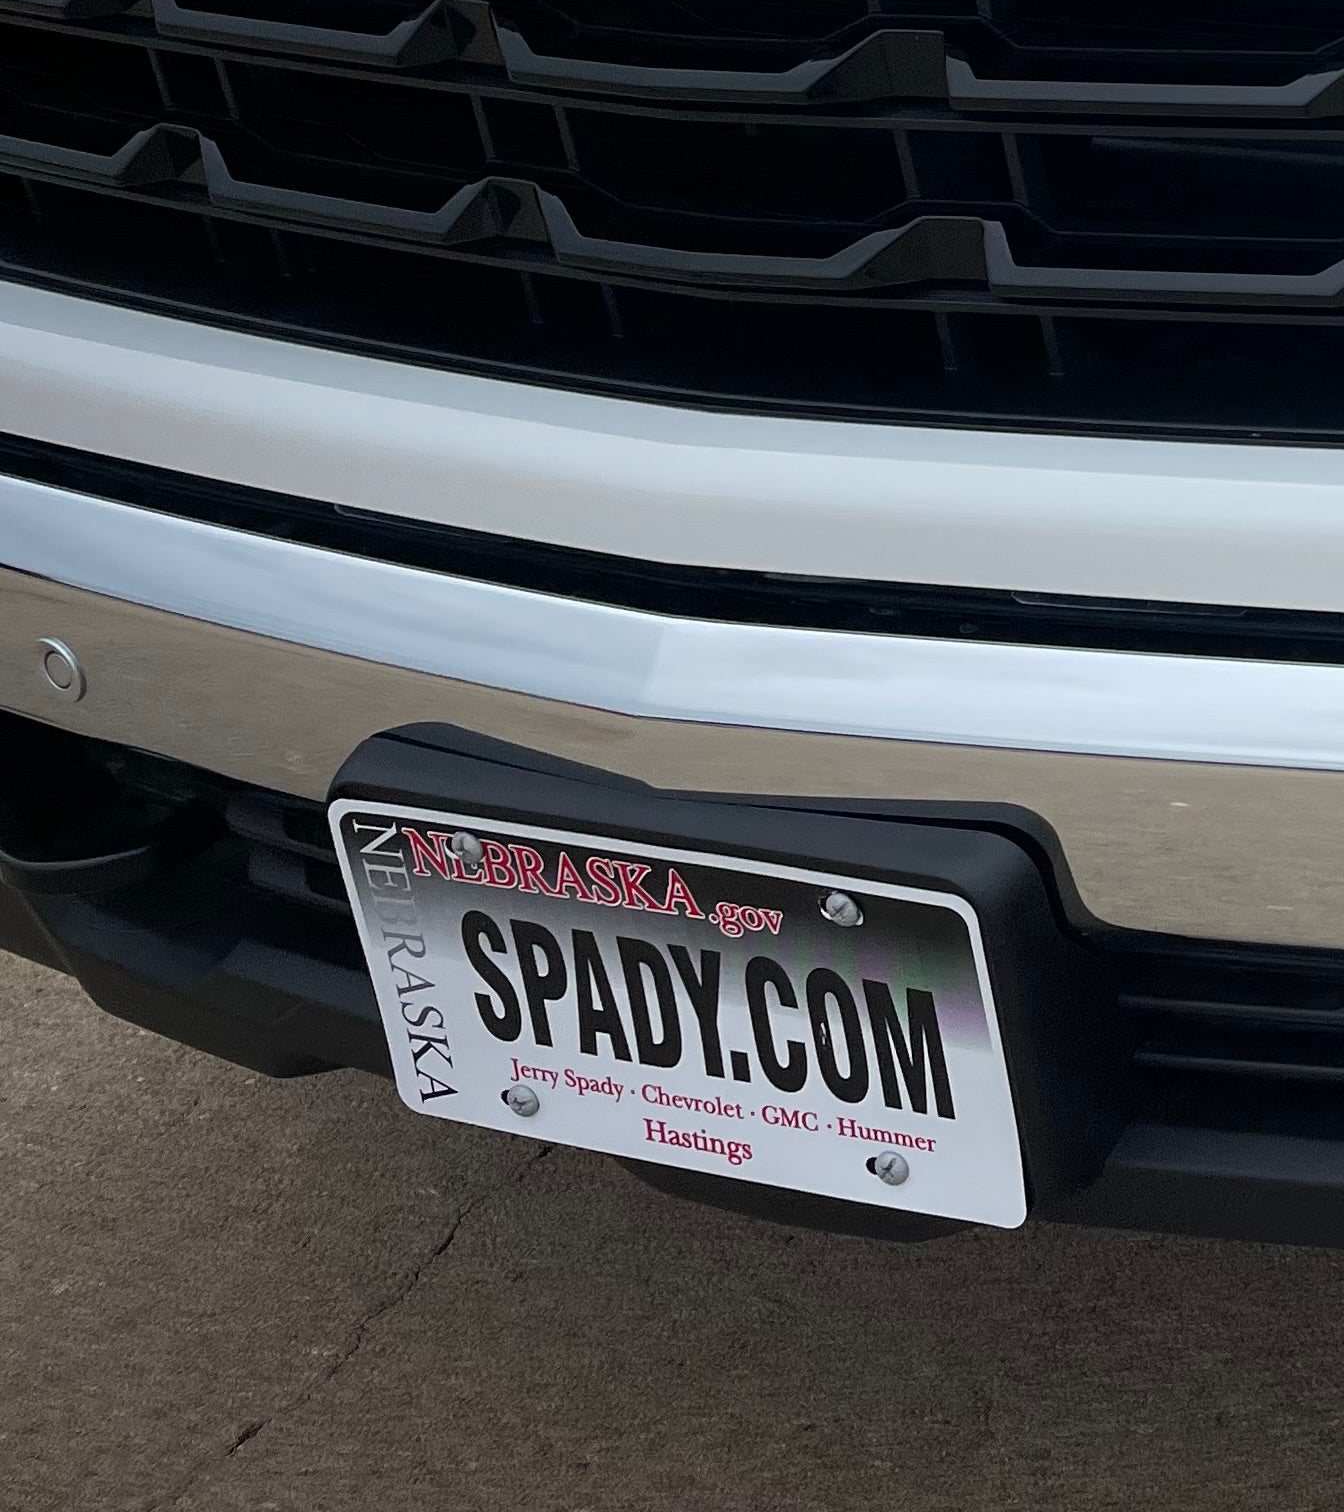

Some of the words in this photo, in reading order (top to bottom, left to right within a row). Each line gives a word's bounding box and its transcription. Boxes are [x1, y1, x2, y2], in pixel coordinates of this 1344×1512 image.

[352, 818, 459, 1105] NEBRASKA
[461, 909, 956, 1120] SPADY.COM
[510, 1058, 559, 1089] Jerry
[564, 1068, 624, 1103] Spady
[641, 1084, 743, 1120] Chevrolet
[761, 1105, 819, 1132] GMC
[837, 1117, 937, 1153] Hummer
[643, 1118, 753, 1166] Hastings
